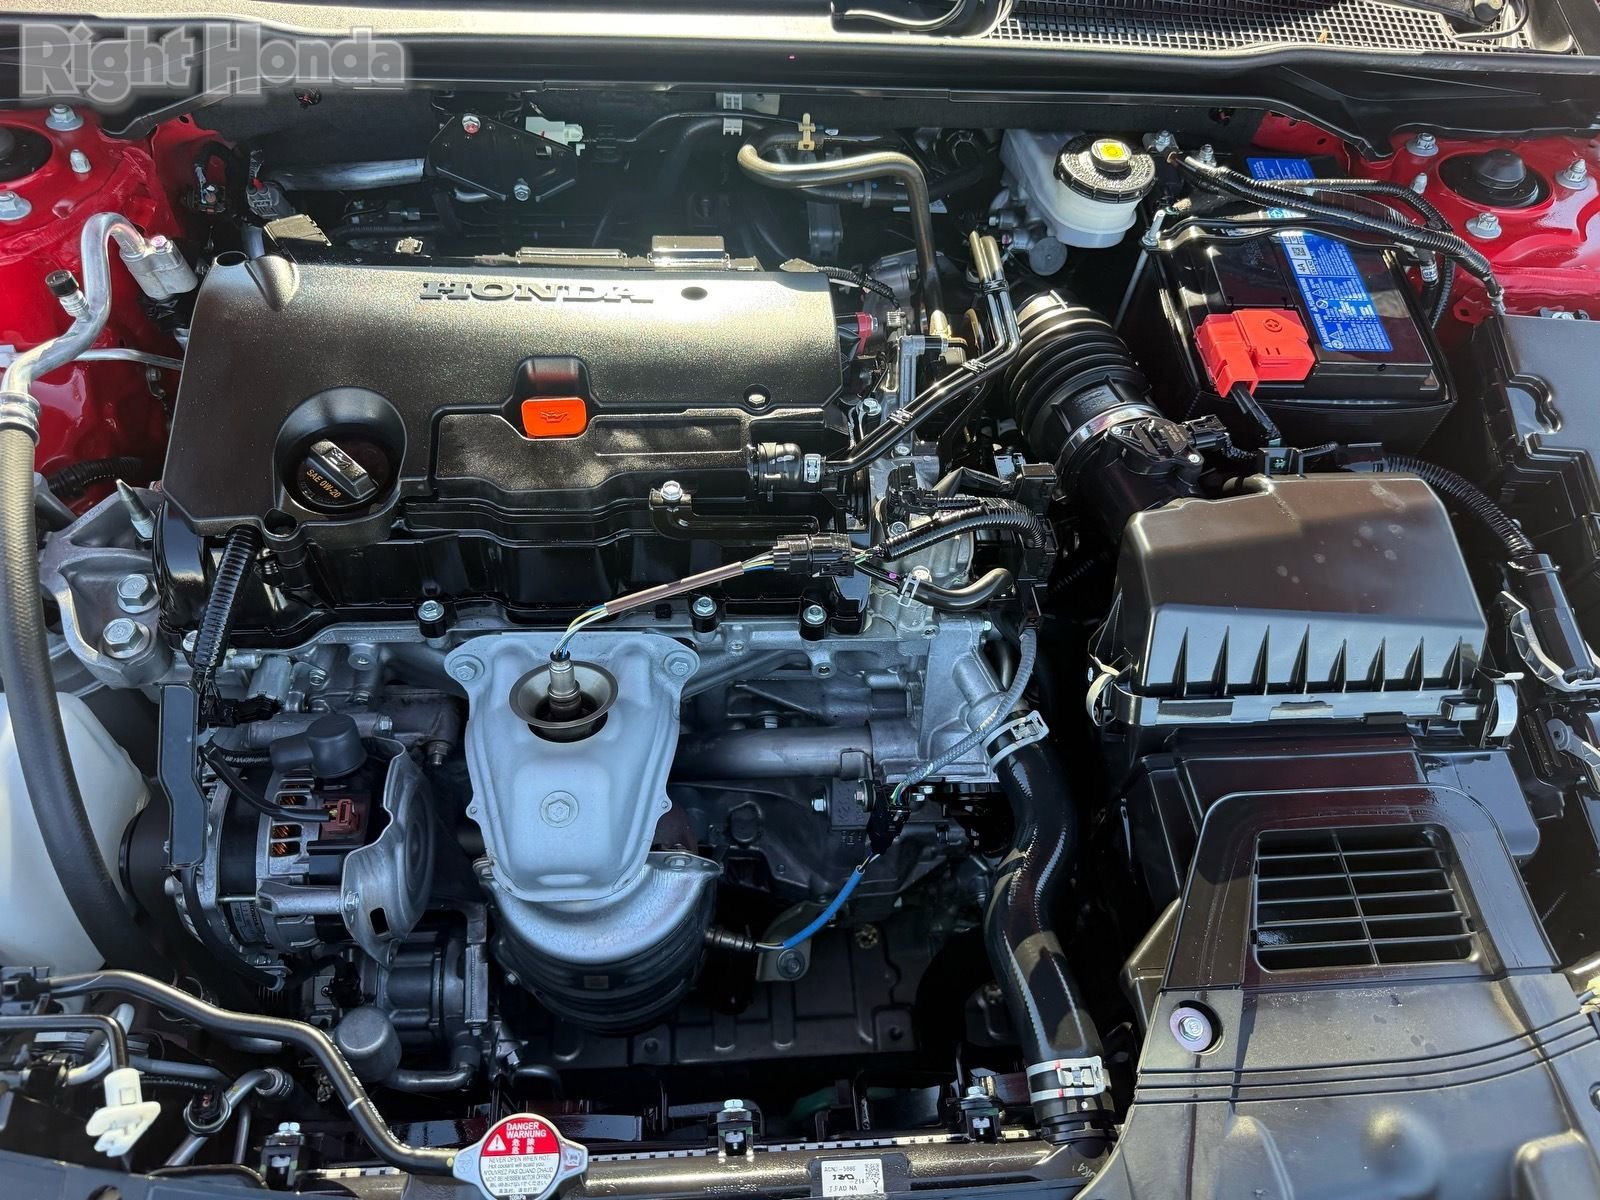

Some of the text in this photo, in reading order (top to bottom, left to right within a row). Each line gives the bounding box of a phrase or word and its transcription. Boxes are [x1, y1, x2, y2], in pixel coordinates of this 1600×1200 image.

[420, 281, 653, 304] HONDA
[306, 469, 323, 483] SAE
[319, 480, 342, 498] 0W-20
[506, 1122, 539, 1130] DANGER
[506, 1129, 546, 1138] WARNUNG
